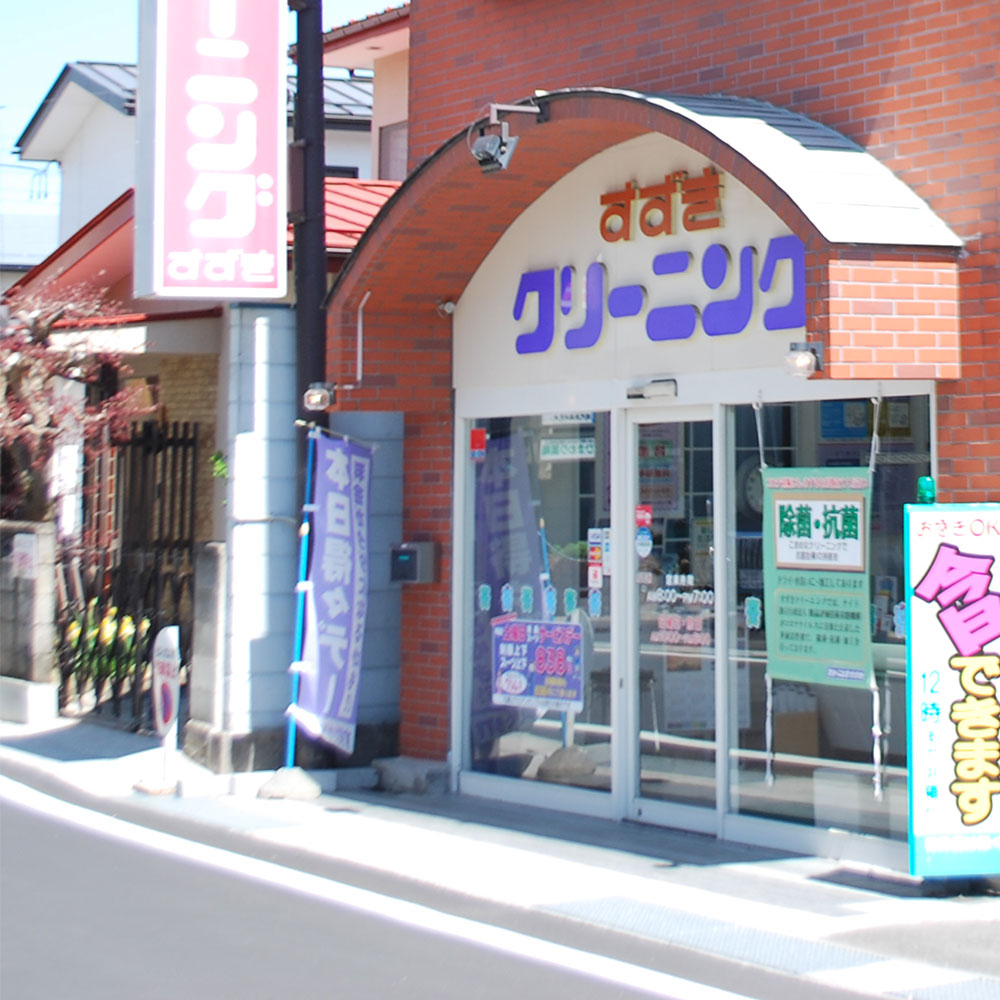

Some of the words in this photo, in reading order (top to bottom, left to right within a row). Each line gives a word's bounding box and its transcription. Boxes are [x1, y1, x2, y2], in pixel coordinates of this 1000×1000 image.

[600, 167, 722, 243] すずき
[167, 249, 275, 283] すずき
[778, 503, 860, 541] 除菌・抗菌
